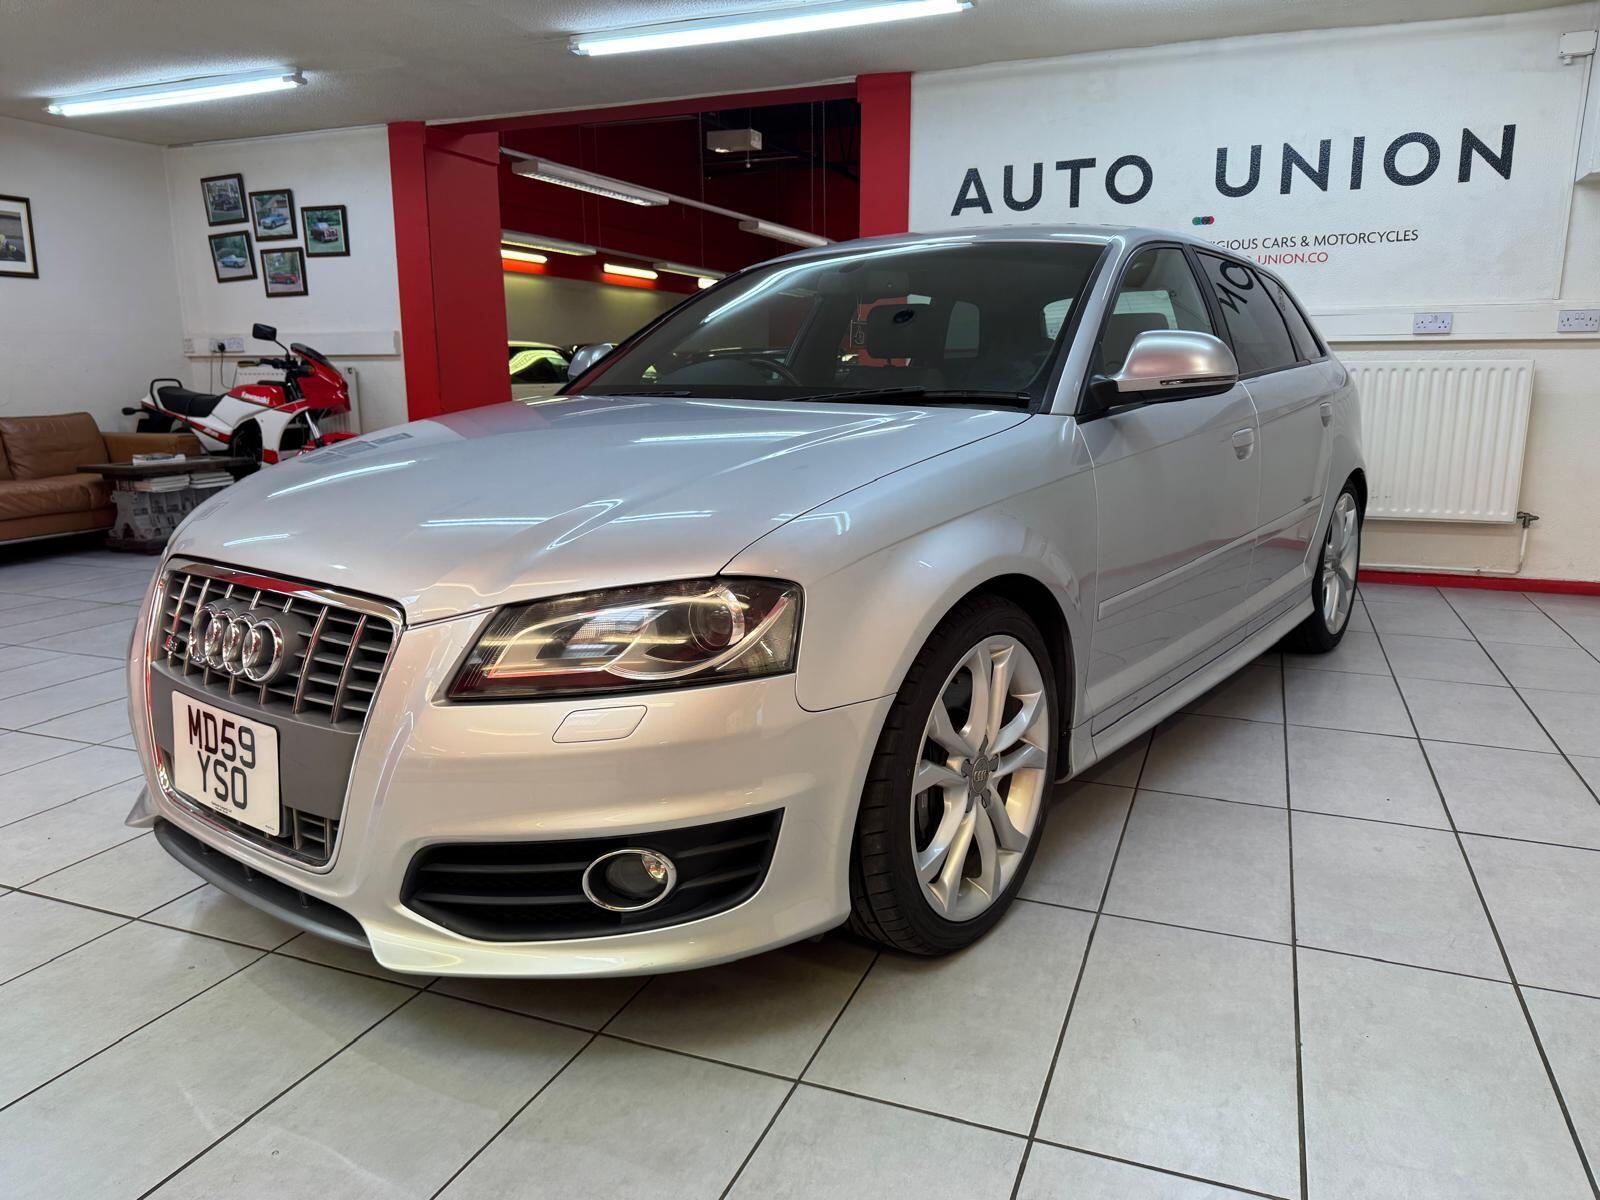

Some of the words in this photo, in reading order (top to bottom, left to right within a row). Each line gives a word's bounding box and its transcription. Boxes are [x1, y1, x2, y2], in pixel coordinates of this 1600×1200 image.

[951, 154, 1153, 216] AUTO
[1215, 124, 1516, 197] UNION
[1262, 236, 1297, 249] CARS
[1300, 235, 1310, 247] &
[1313, 229, 1419, 246] MOTORCYCLES
[187, 704, 256, 769] MD59
[197, 750, 248, 810] YSO
